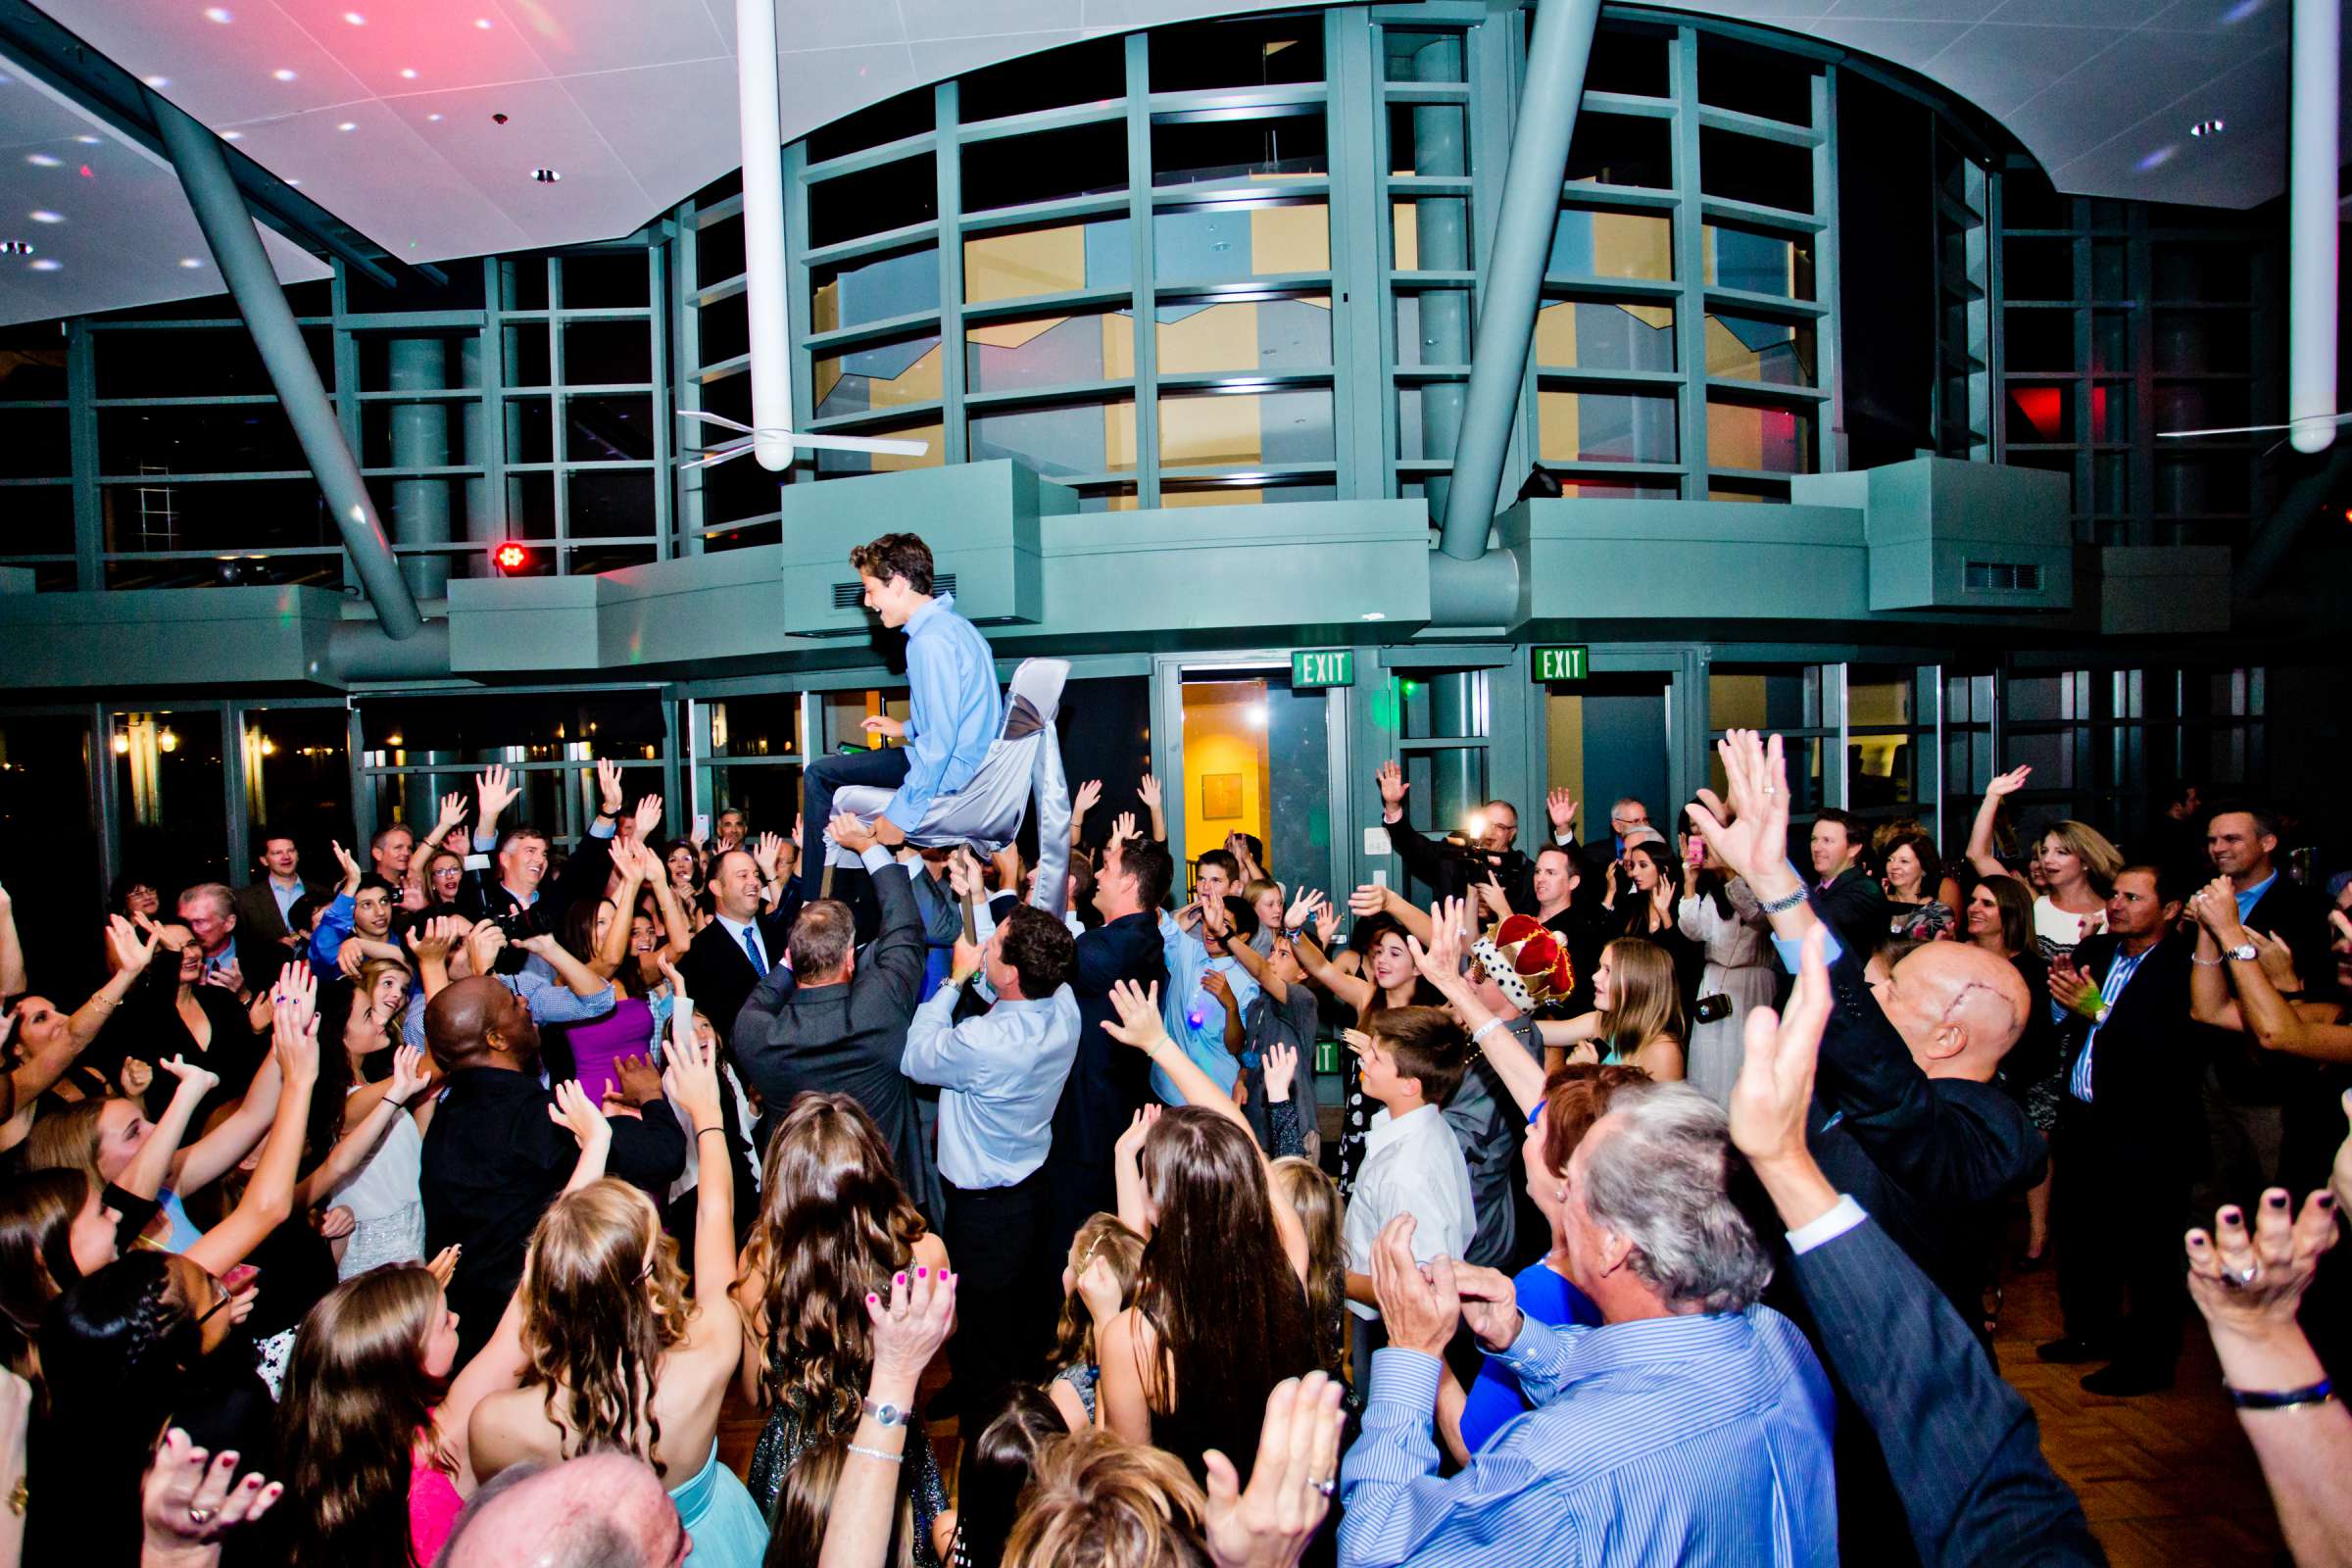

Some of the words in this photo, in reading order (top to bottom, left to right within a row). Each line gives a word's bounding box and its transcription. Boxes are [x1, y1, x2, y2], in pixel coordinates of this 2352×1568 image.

[1303, 654, 1345, 682] EXIT
[1544, 650, 1580, 678] EXIT
[1315, 1045, 1332, 1071] IT
